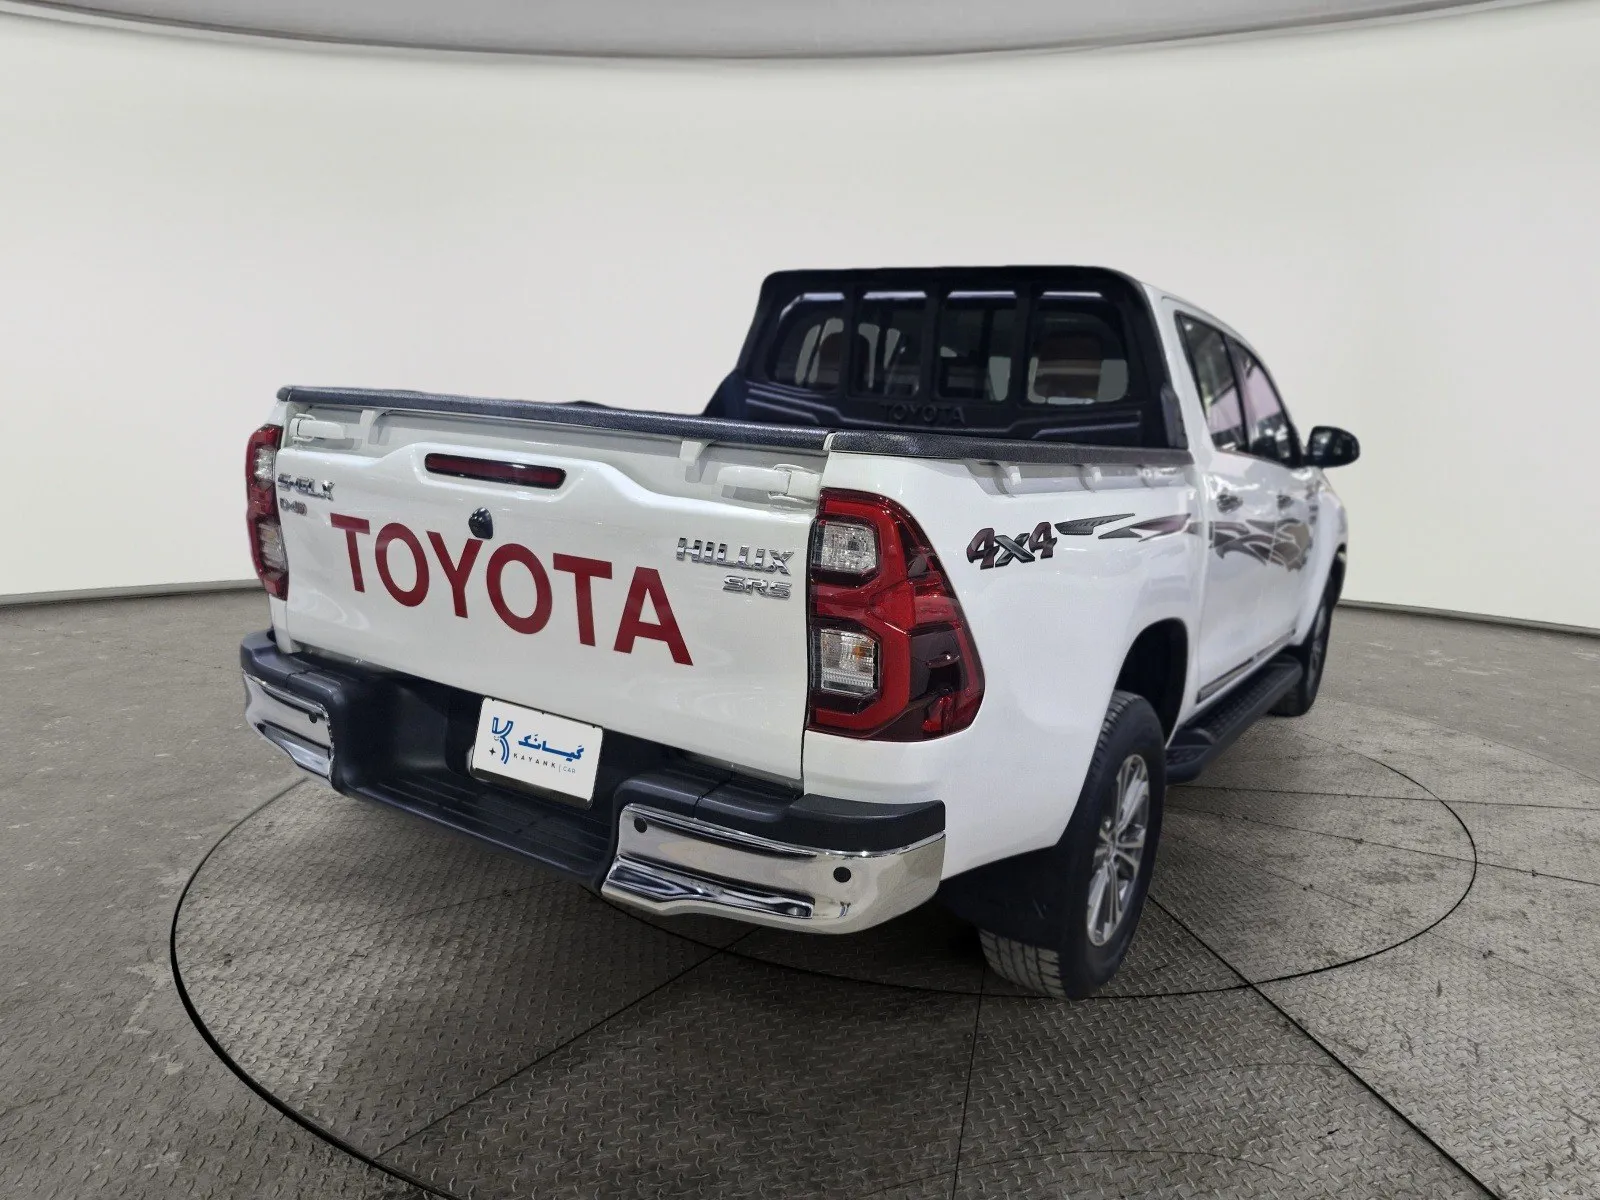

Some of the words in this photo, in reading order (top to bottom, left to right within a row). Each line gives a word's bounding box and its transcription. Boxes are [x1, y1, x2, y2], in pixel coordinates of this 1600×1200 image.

[879, 403, 966, 426] TOYOTA
[676, 537, 795, 576] HILUX
[330, 512, 694, 667] TOYOTA
[513, 753, 556, 768] KAYANK
